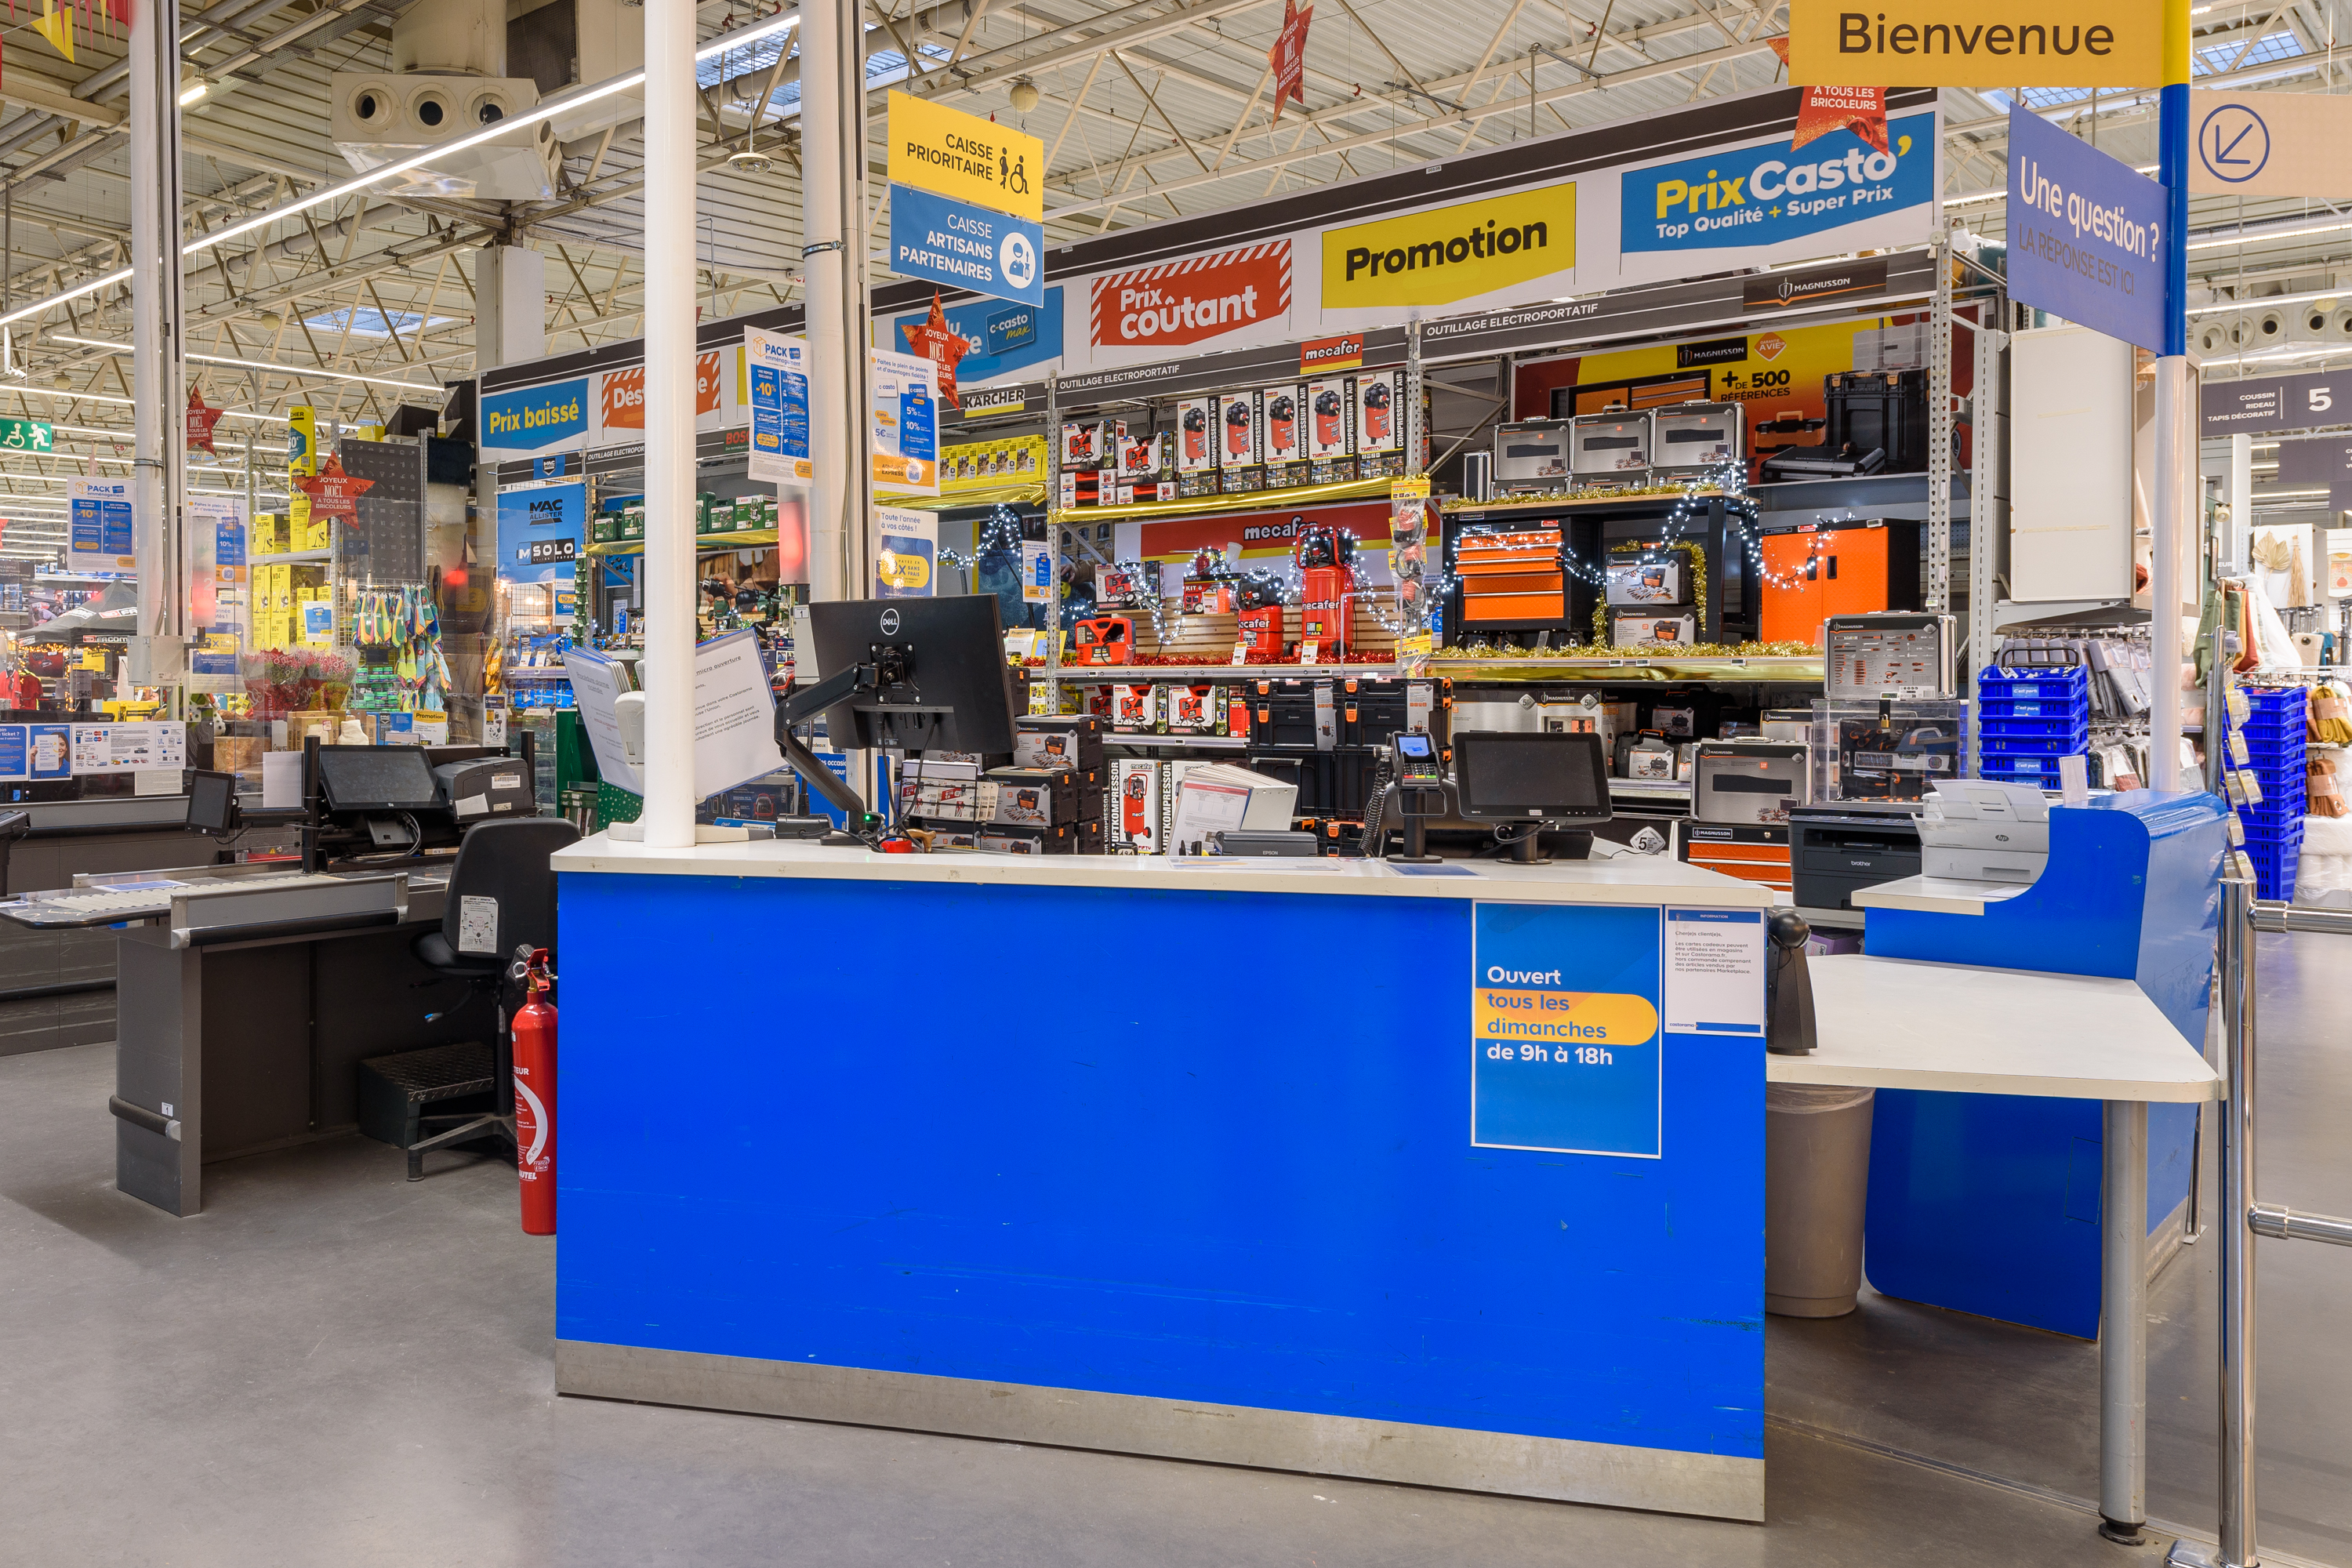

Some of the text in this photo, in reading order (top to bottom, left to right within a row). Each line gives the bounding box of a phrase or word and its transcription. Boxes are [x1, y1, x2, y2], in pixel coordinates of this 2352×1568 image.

[1282, 18, 1298, 43] JOYEUX
[1839, 13, 2114, 56] Bienvenue
[1279, 65, 1300, 90] BRICOLEURS
[1824, 86, 1875, 98] TOUS LES
[1810, 97, 1877, 110] BRICOLEURS
[946, 133, 993, 161] CAISSE
[907, 142, 993, 180] PRIORITAIRE
[1657, 169, 1746, 220] Prix
[1656, 184, 1893, 239] Top Qualité + Super Prix
[2020, 156, 2159, 263] Une question ?
[947, 214, 992, 239] CAISSE
[927, 230, 993, 260] ARTISANS
[1346, 220, 1547, 281] Promotion
[900, 245, 992, 281] PARTENAIRES
[2020, 223, 2134, 296] LA RÉPONSE EST ICI
[1795, 278, 1850, 292] MAGNUSSON
[1120, 284, 1162, 312] Prix
[1120, 285, 1257, 339] coûtant
[1427, 303, 1599, 336] OUTILLAGE ELECTROPORTATIF
[989, 314, 1028, 334] c-casto
[1006, 325, 1031, 340] max
[925, 328, 949, 342] JOYEUX
[765, 343, 787, 358] PACK
[929, 340, 945, 362] NOËL
[1305, 339, 1360, 361] mecafer
[1694, 347, 1744, 359] MAGNUSSON
[765, 355, 800, 367] emménagement
[883, 367, 910, 377] d'avantages
[911, 372, 926, 380] fidélité
[1059, 365, 1180, 390] OUTILLAGE ELECTROPORTATIF
[1735, 381, 1748, 390] DE
[1751, 369, 1791, 388] 500
[964, 390, 1025, 408] KÄRCHER
[1721, 387, 1791, 402] RÉFÉRENCES
[2239, 392, 2275, 401] COUSSIN
[2309, 387, 2332, 411] 5
[906, 407, 917, 416] 5%
[2245, 401, 2275, 409] RIDEAU
[190, 415, 203, 428] NOËL
[490, 397, 579, 434] Prix baissé
[2208, 410, 2276, 422] TAPIS DÉCORATIF
[906, 421, 920, 430] 10%
[588, 446, 644, 460] OUTILLAGE ELECTROPOR
[325, 484, 343, 498] NOËL
[529, 499, 563, 514] MAC
[529, 511, 563, 520] ALLISTER
[899, 515, 920, 524] l'année
[533, 543, 573, 557] SOLO
[696, 655, 741, 675] micro ouverture
[729, 687, 753, 698] Castorama
[724, 709, 744, 720] personnel
[724, 716, 760, 731] agréable journée.
[1639, 837, 1646, 850] 5
[1487, 966, 1561, 985] Ouvert
[1487, 993, 1570, 1011] tous les
[1487, 1018, 1607, 1039] dimanches
[1487, 1043, 1613, 1065] de 9h à 18h
